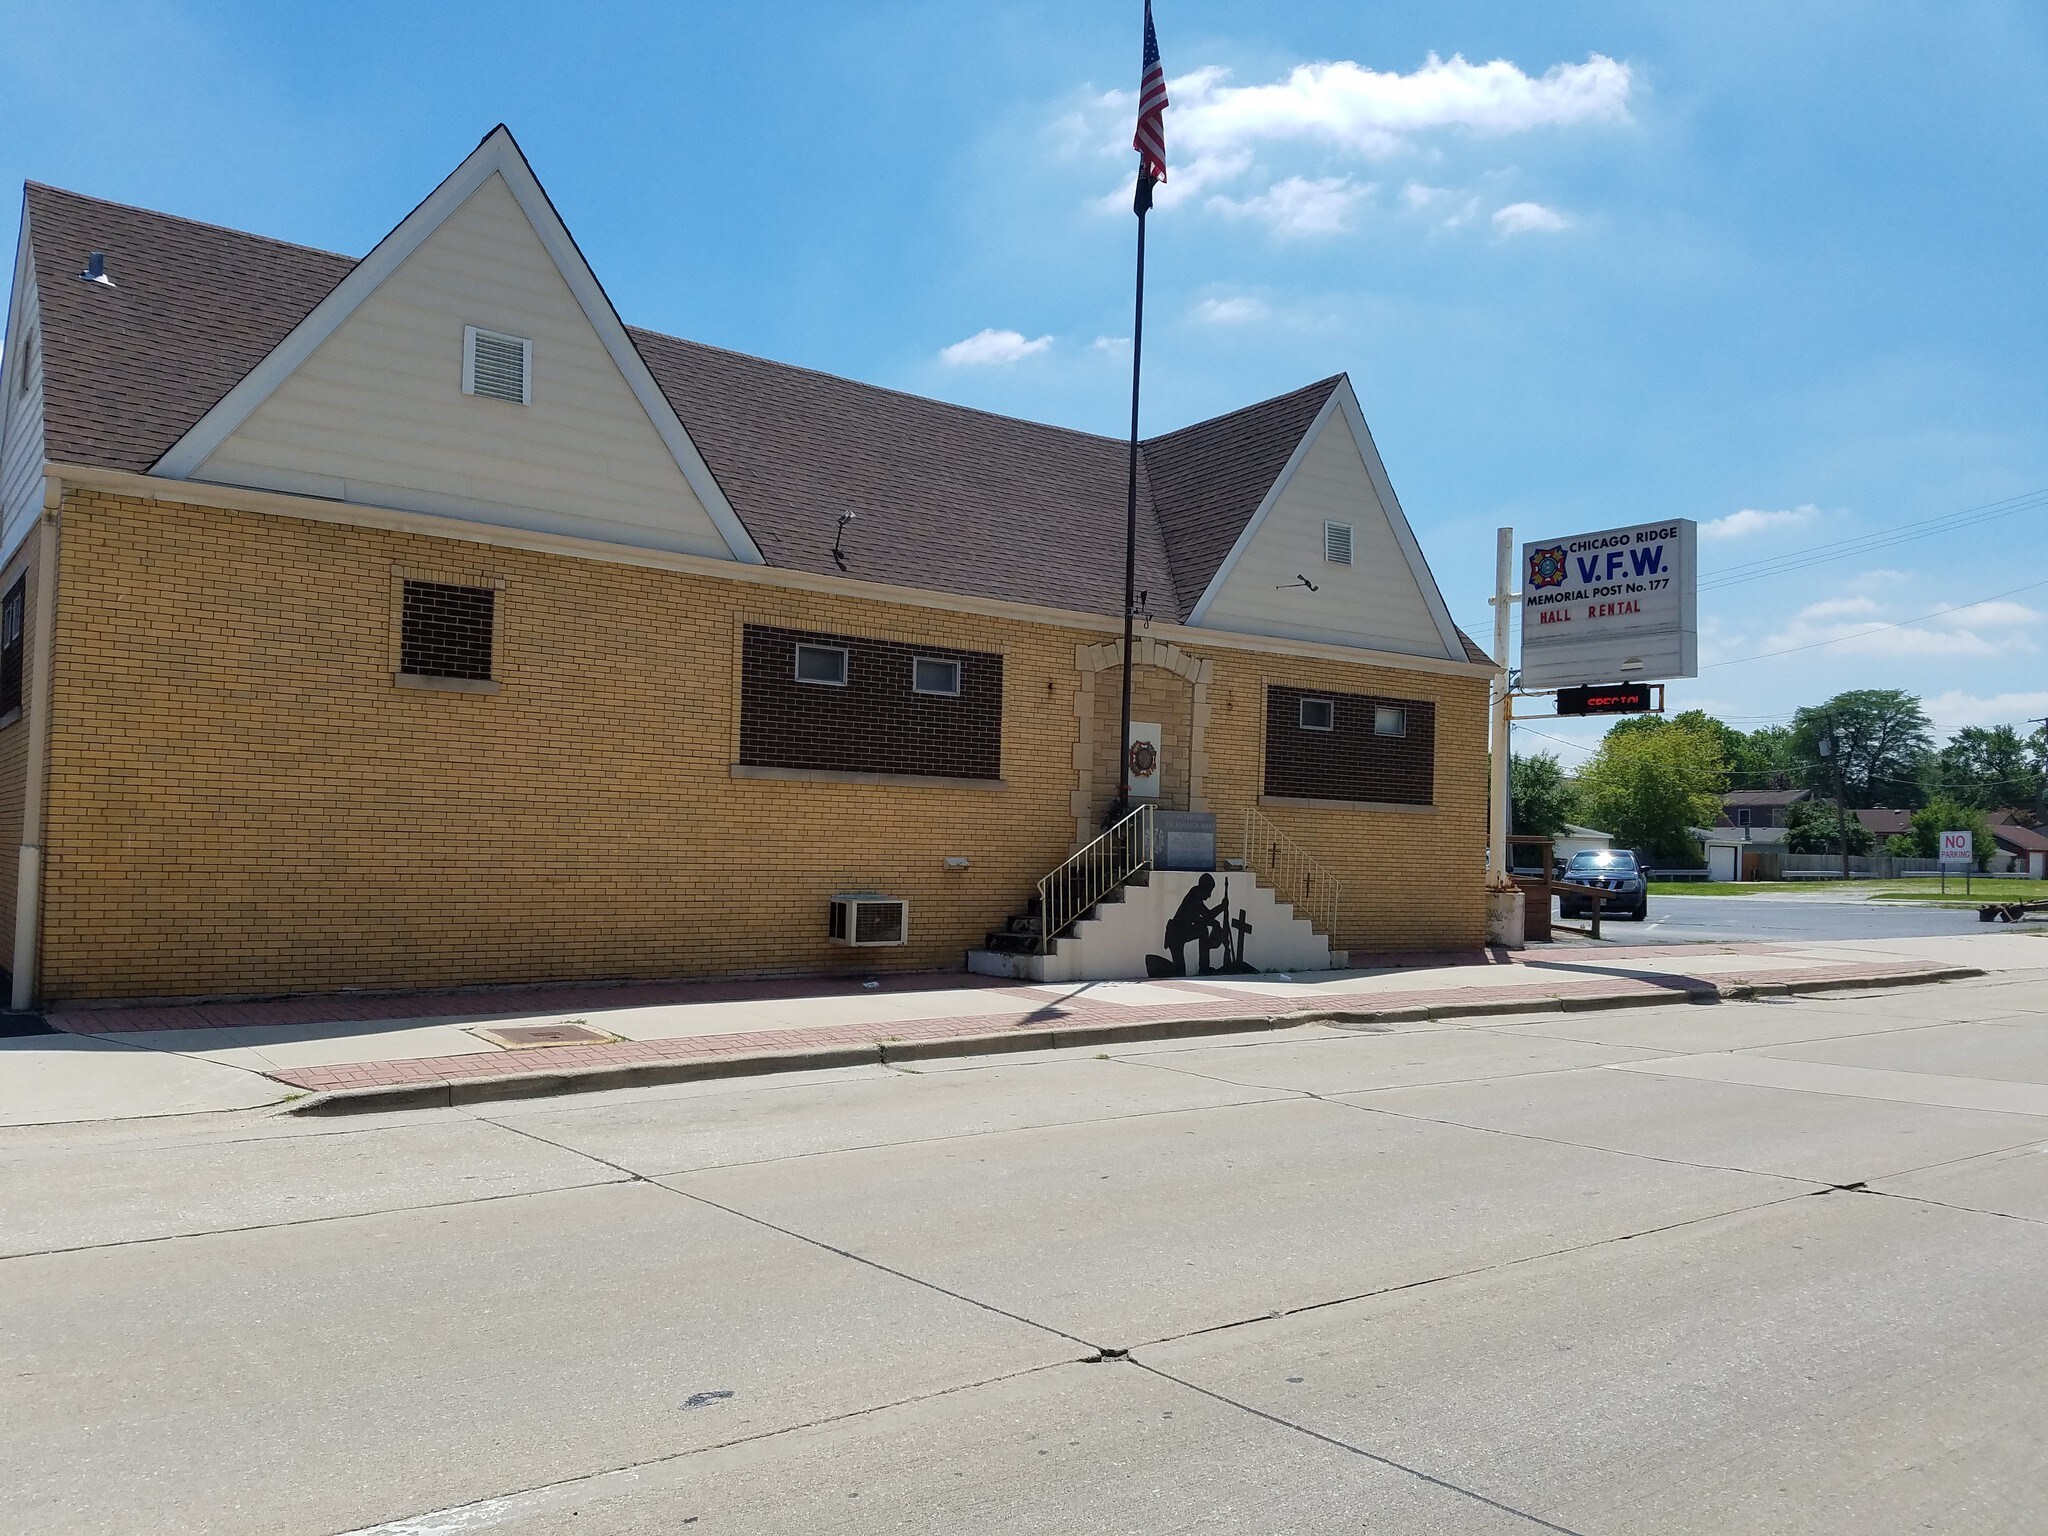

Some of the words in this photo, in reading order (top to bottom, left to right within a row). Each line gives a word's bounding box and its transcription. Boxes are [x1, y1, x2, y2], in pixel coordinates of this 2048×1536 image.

[1569, 534, 1631, 553] CHICAGO
[1636, 526, 1678, 543] RIDGE
[1576, 545, 1669, 584] V.F.W.
[1527, 589, 1590, 606] MEMORIAL
[1592, 584, 1623, 598] POST
[1625, 582, 1647, 594] No.
[1648, 578, 1670, 591] 177
[1540, 608, 1571, 624] HALL
[1588, 600, 1641, 618] RENTAL
[1941, 850, 1970, 859] PARKING
[1945, 835, 1966, 849] NO
